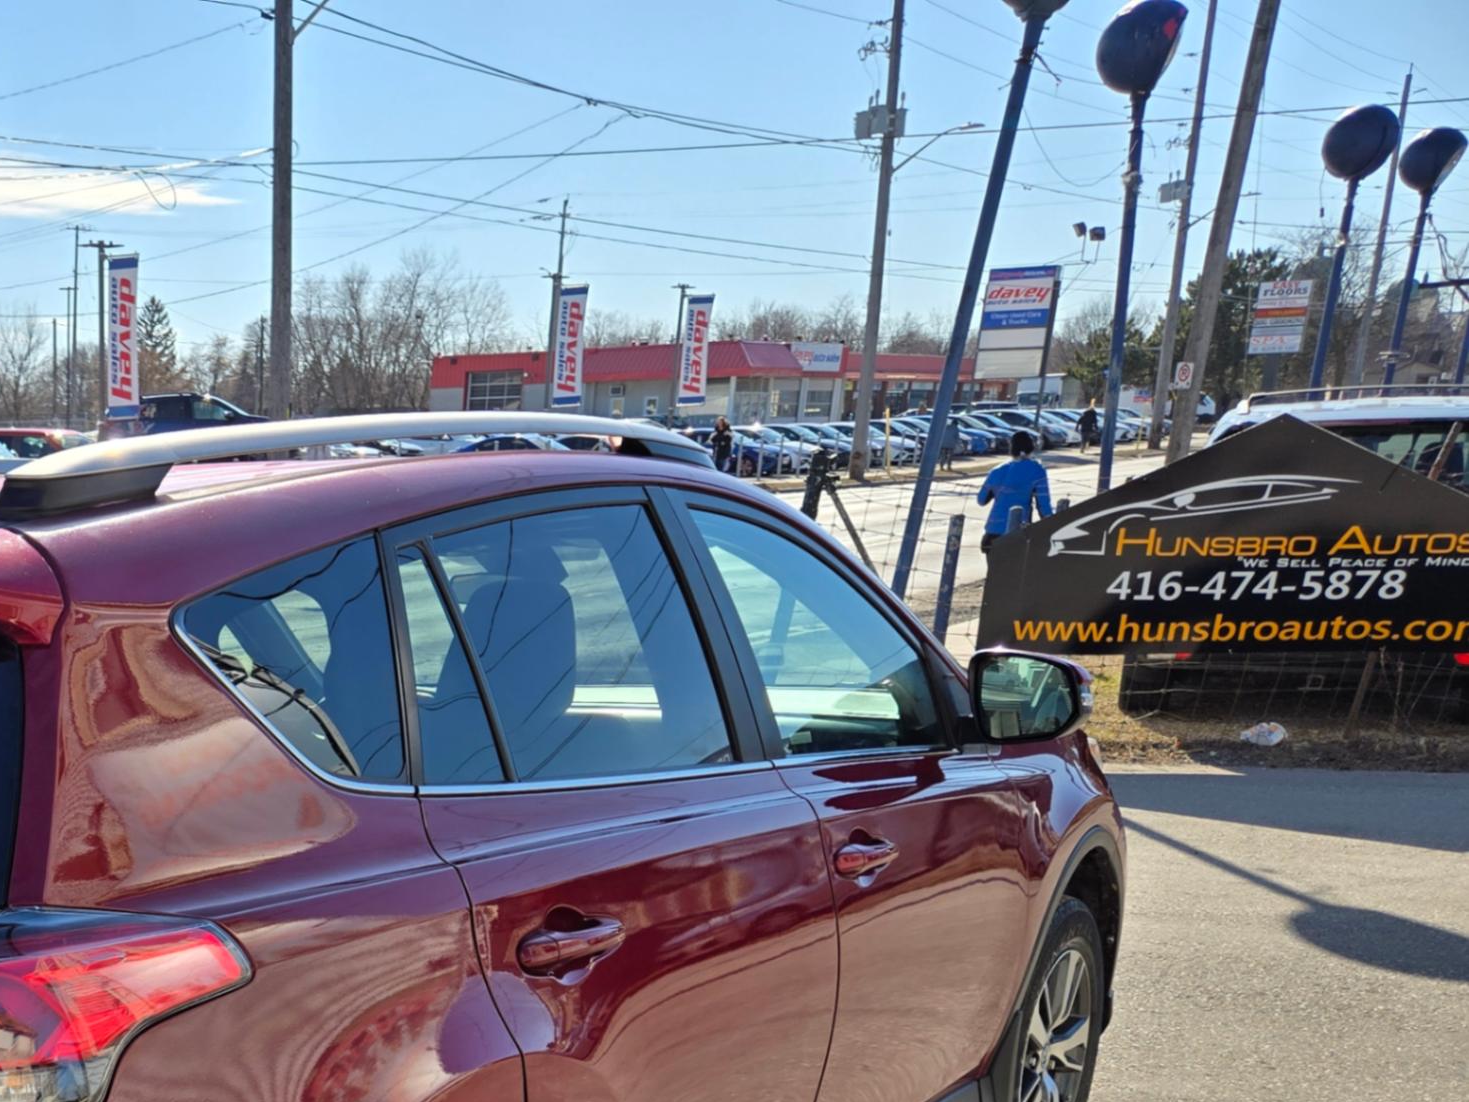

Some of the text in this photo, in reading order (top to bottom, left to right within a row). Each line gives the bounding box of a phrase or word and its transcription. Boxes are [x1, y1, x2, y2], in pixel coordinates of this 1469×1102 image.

[988, 286, 1051, 303] davey
[560, 300, 569, 336] auto
[687, 309, 695, 342] auto
[111, 277, 136, 401] davey
[557, 301, 583, 393] davey
[682, 309, 708, 394] davey
[1106, 569, 1407, 601] 416-474-5878
